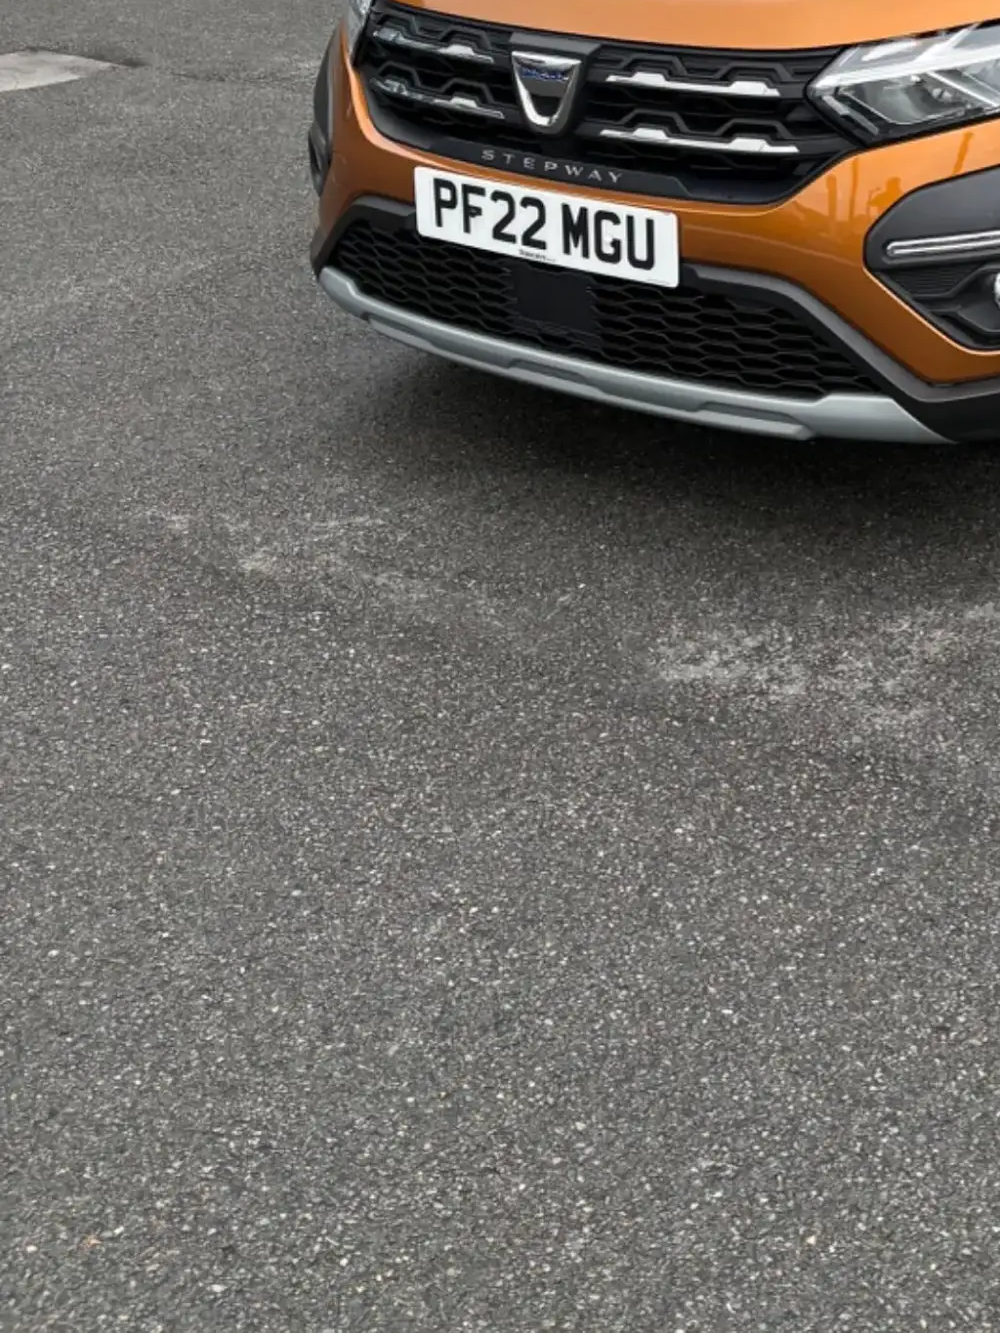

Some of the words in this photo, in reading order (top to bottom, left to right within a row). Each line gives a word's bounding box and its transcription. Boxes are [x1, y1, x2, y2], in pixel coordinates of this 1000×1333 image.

[481, 149, 623, 183] STEPWAY
[433, 177, 547, 250] PF22
[561, 203, 655, 271] MGU
